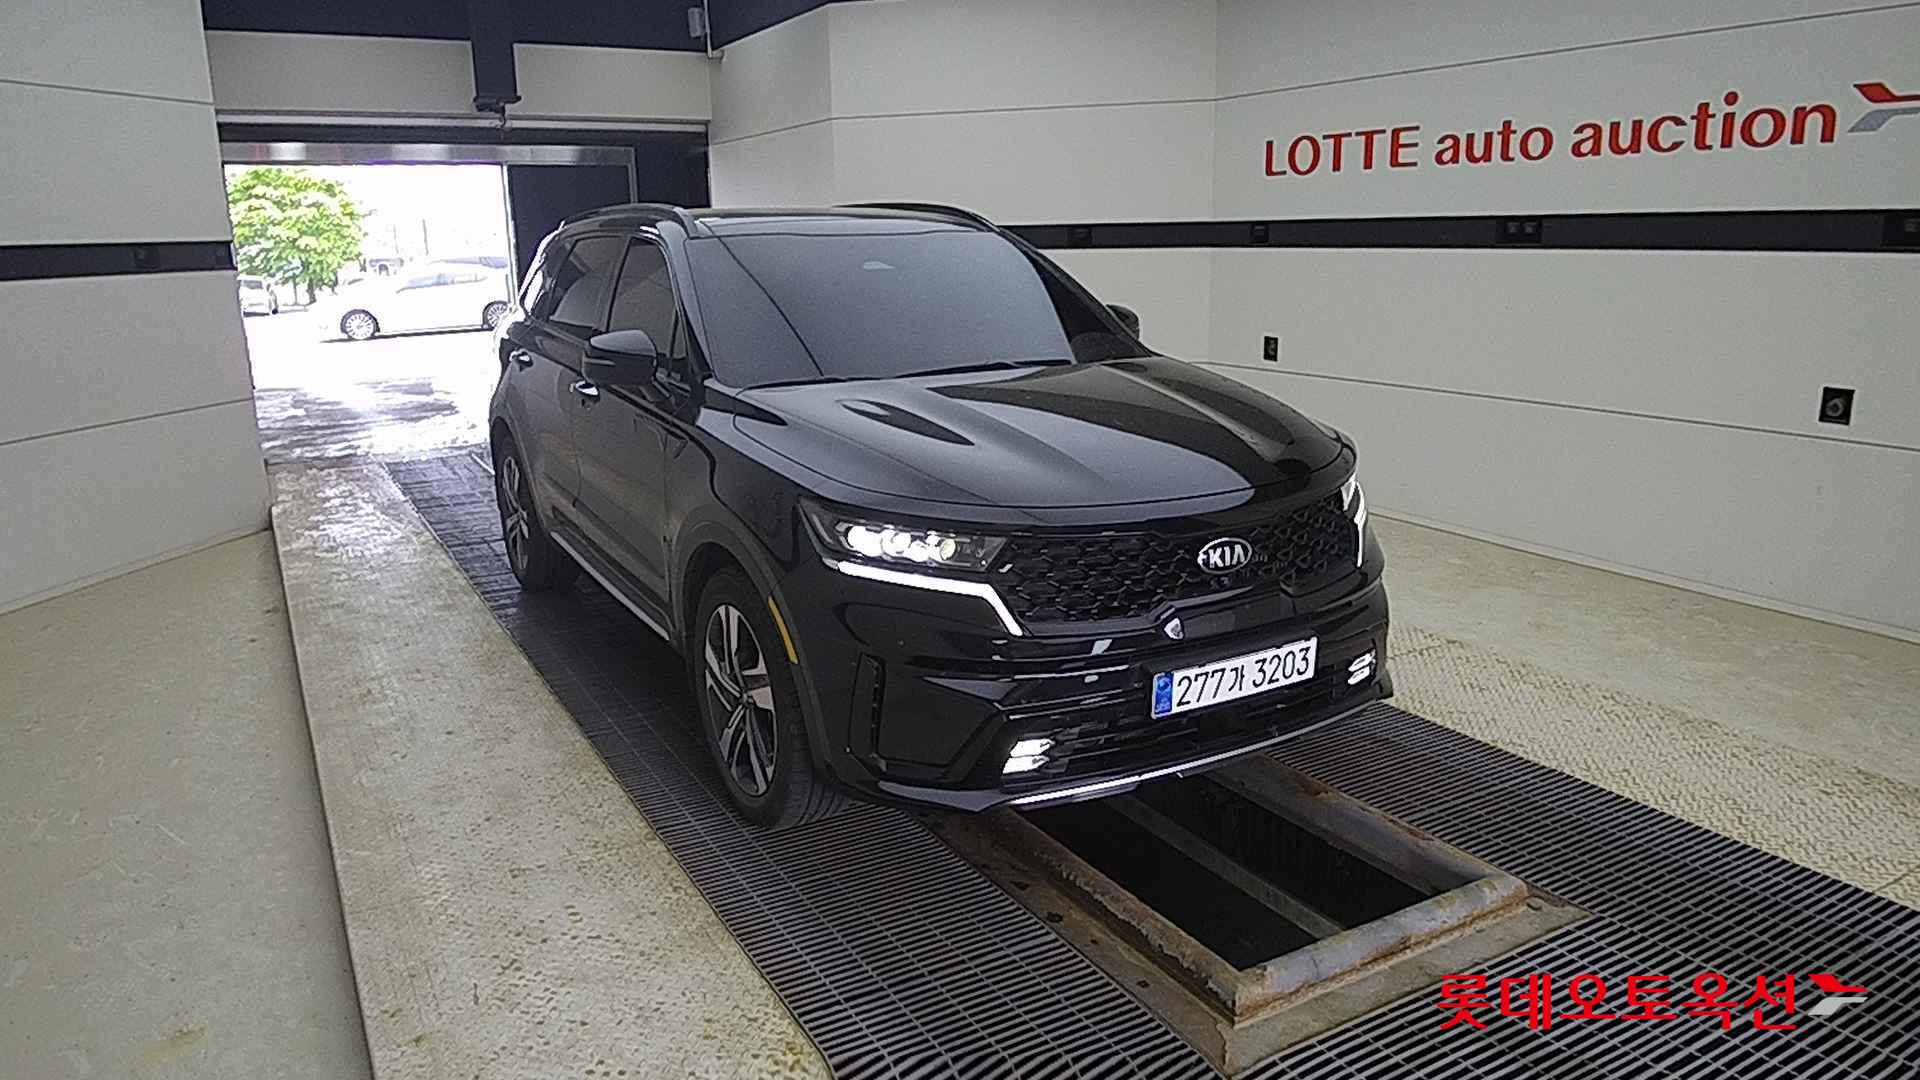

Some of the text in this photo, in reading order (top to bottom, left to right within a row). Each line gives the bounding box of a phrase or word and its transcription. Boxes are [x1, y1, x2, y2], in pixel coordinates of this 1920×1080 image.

[1264, 91, 1838, 177] LOTTE auto auction
[1207, 543, 1246, 569] KIA
[1176, 646, 1312, 707] 277가 3203
